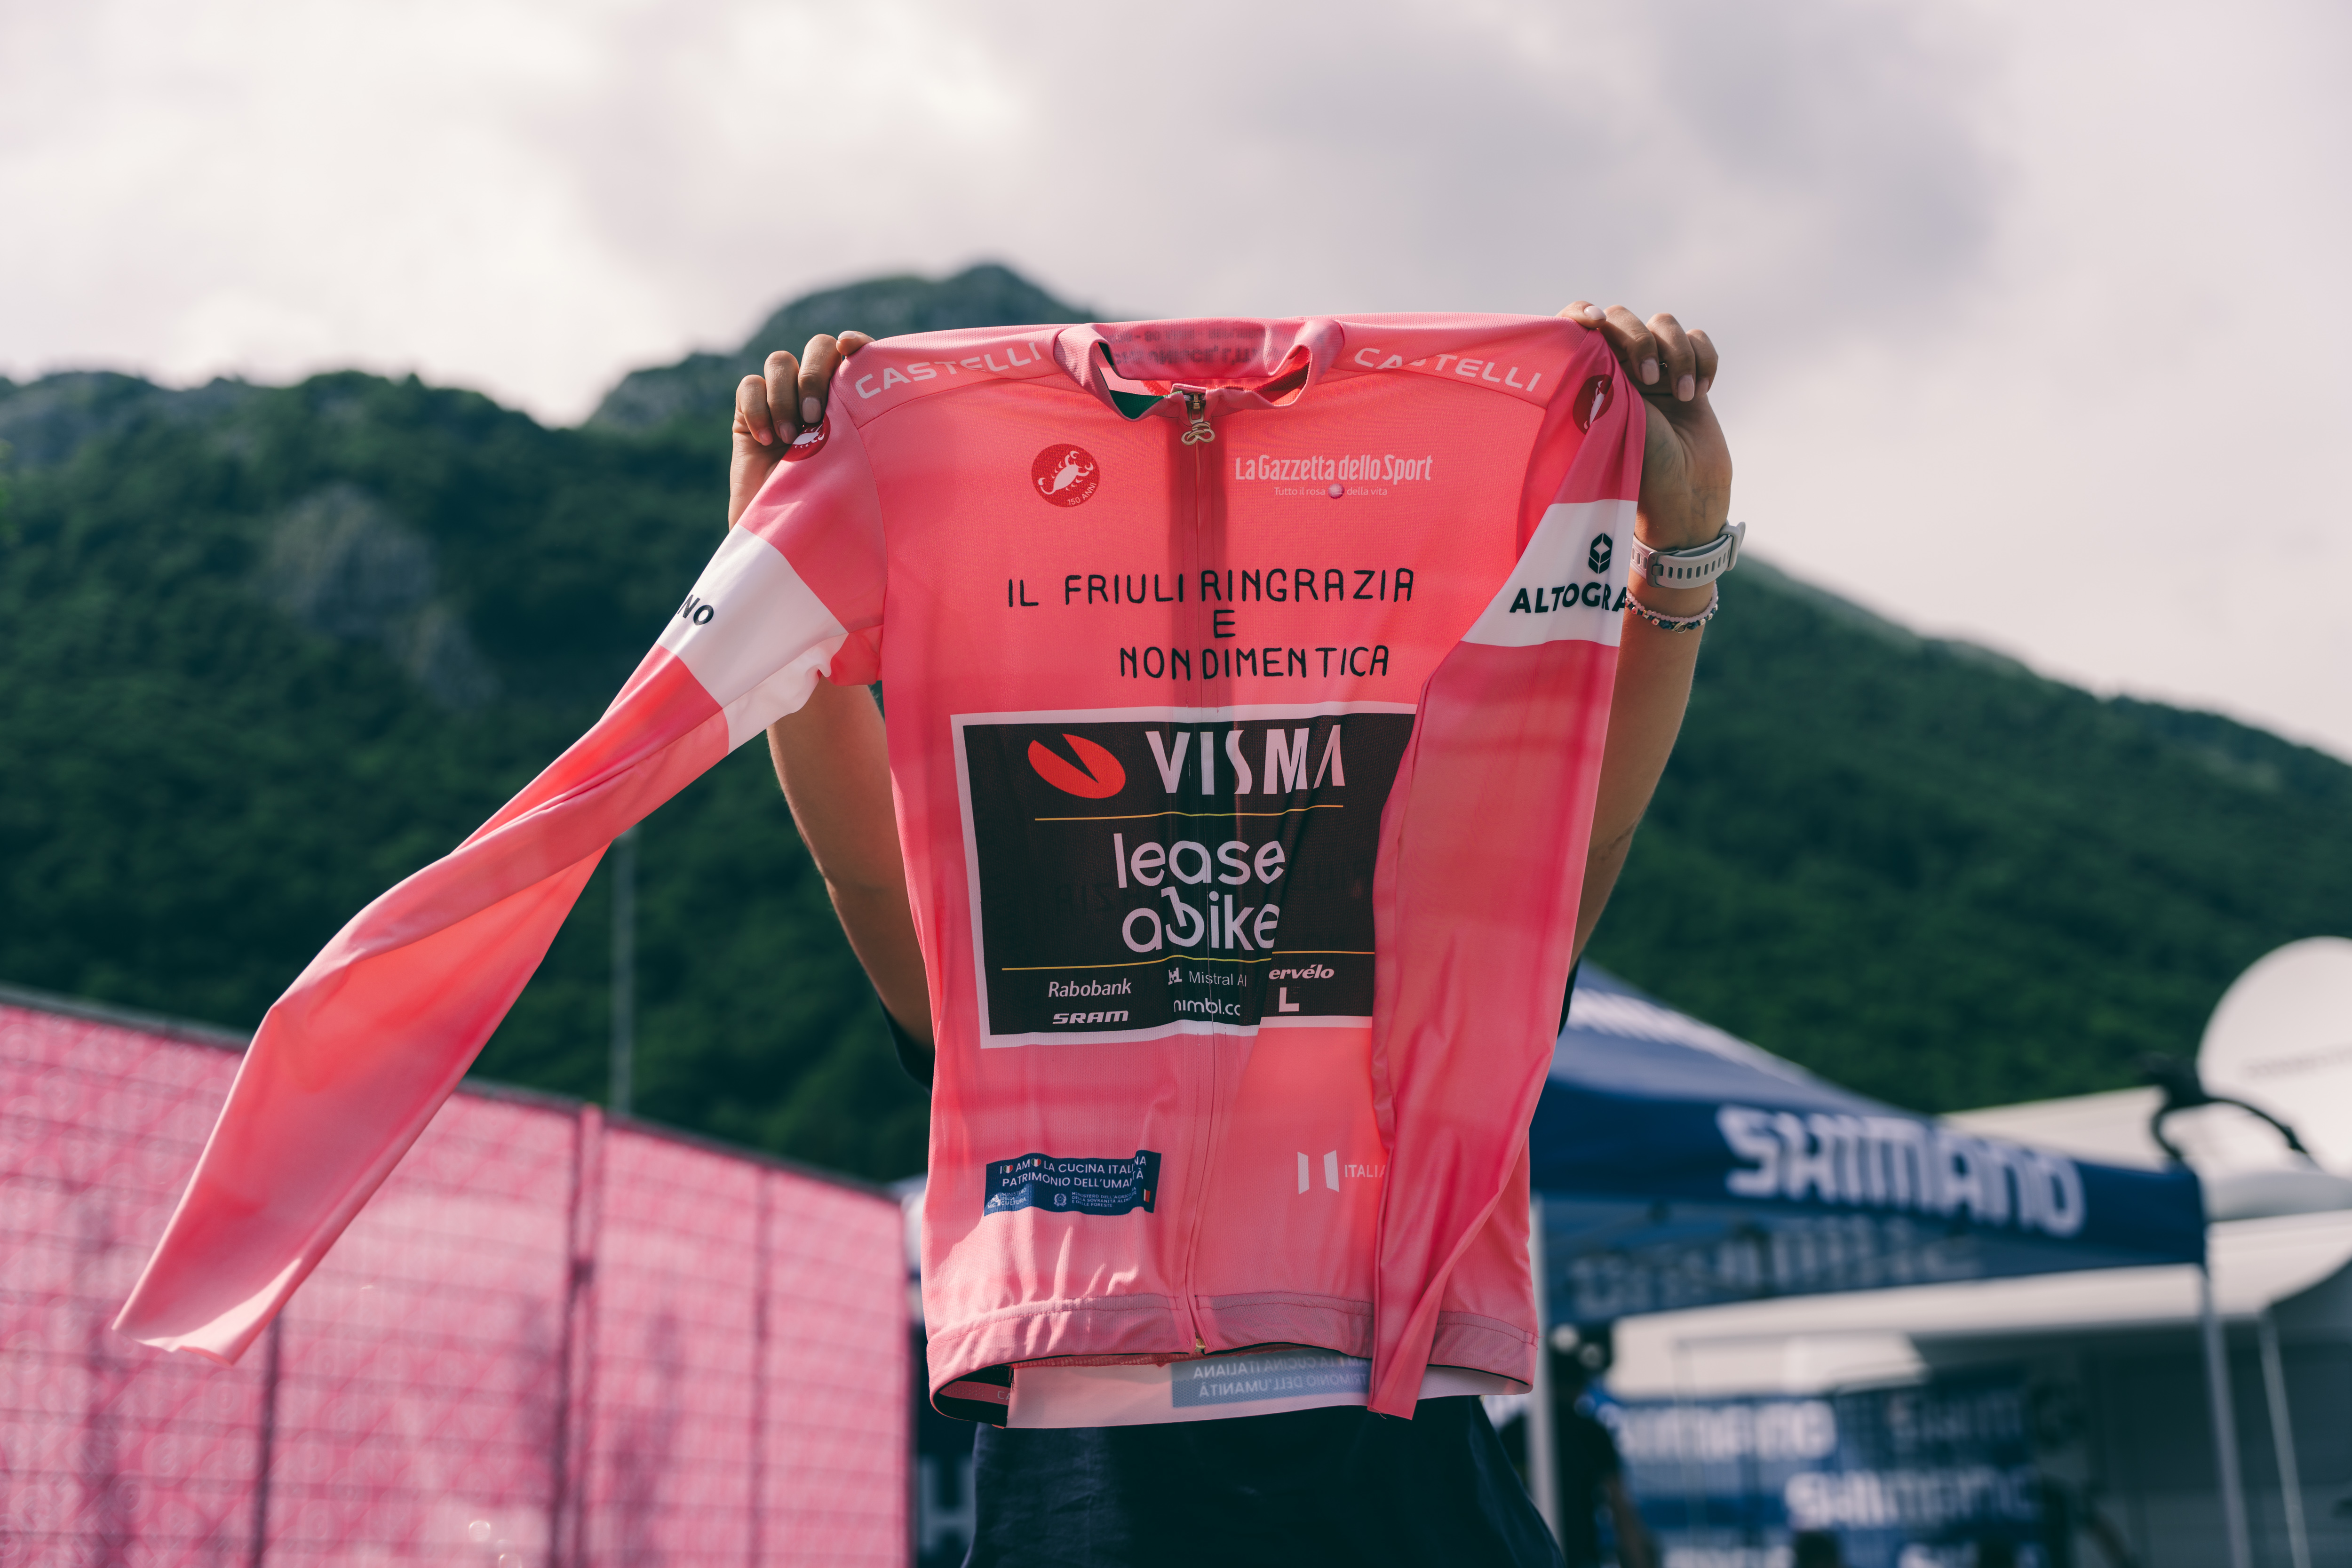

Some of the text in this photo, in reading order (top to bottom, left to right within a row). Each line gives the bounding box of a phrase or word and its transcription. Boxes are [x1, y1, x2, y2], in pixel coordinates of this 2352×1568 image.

[855, 342, 1041, 399] CASTELLI
[1258, 454, 1334, 480] Gazzetta
[1338, 454, 1380, 480] dello
[1382, 454, 1433, 485] Sport
[1067, 482, 1097, 506] 150 ANNI
[1274, 487, 1297, 495] Tutto
[1299, 487, 1304, 495] il
[1347, 487, 1368, 495] della
[1009, 567, 1414, 607] IL FRIULI RINGRAZIA
[1214, 609, 1236, 638] E
[1120, 645, 1389, 681] NON DIMENTICA
[1145, 724, 1345, 795] VISMA
[1113, 833, 1285, 888] lease
[1189, 971, 1233, 985] Mistral
[1269, 964, 1334, 979] ervélo
[1048, 978, 1132, 997] Rabobank
[1052, 1010, 1128, 1024] SRAM
[1044, 1160, 1055, 1172] LA
[1058, 1163, 1105, 1174] CUCINA
[1109, 1156, 1146, 1174] ITALINA
[1716, 1102, 2085, 1237] SHIMANO
[1002, 1172, 1071, 1186] PATRIMONIO
[1001, 1188, 1026, 1196] MINISTERO
[1001, 1197, 1026, 1205] CULTURA
